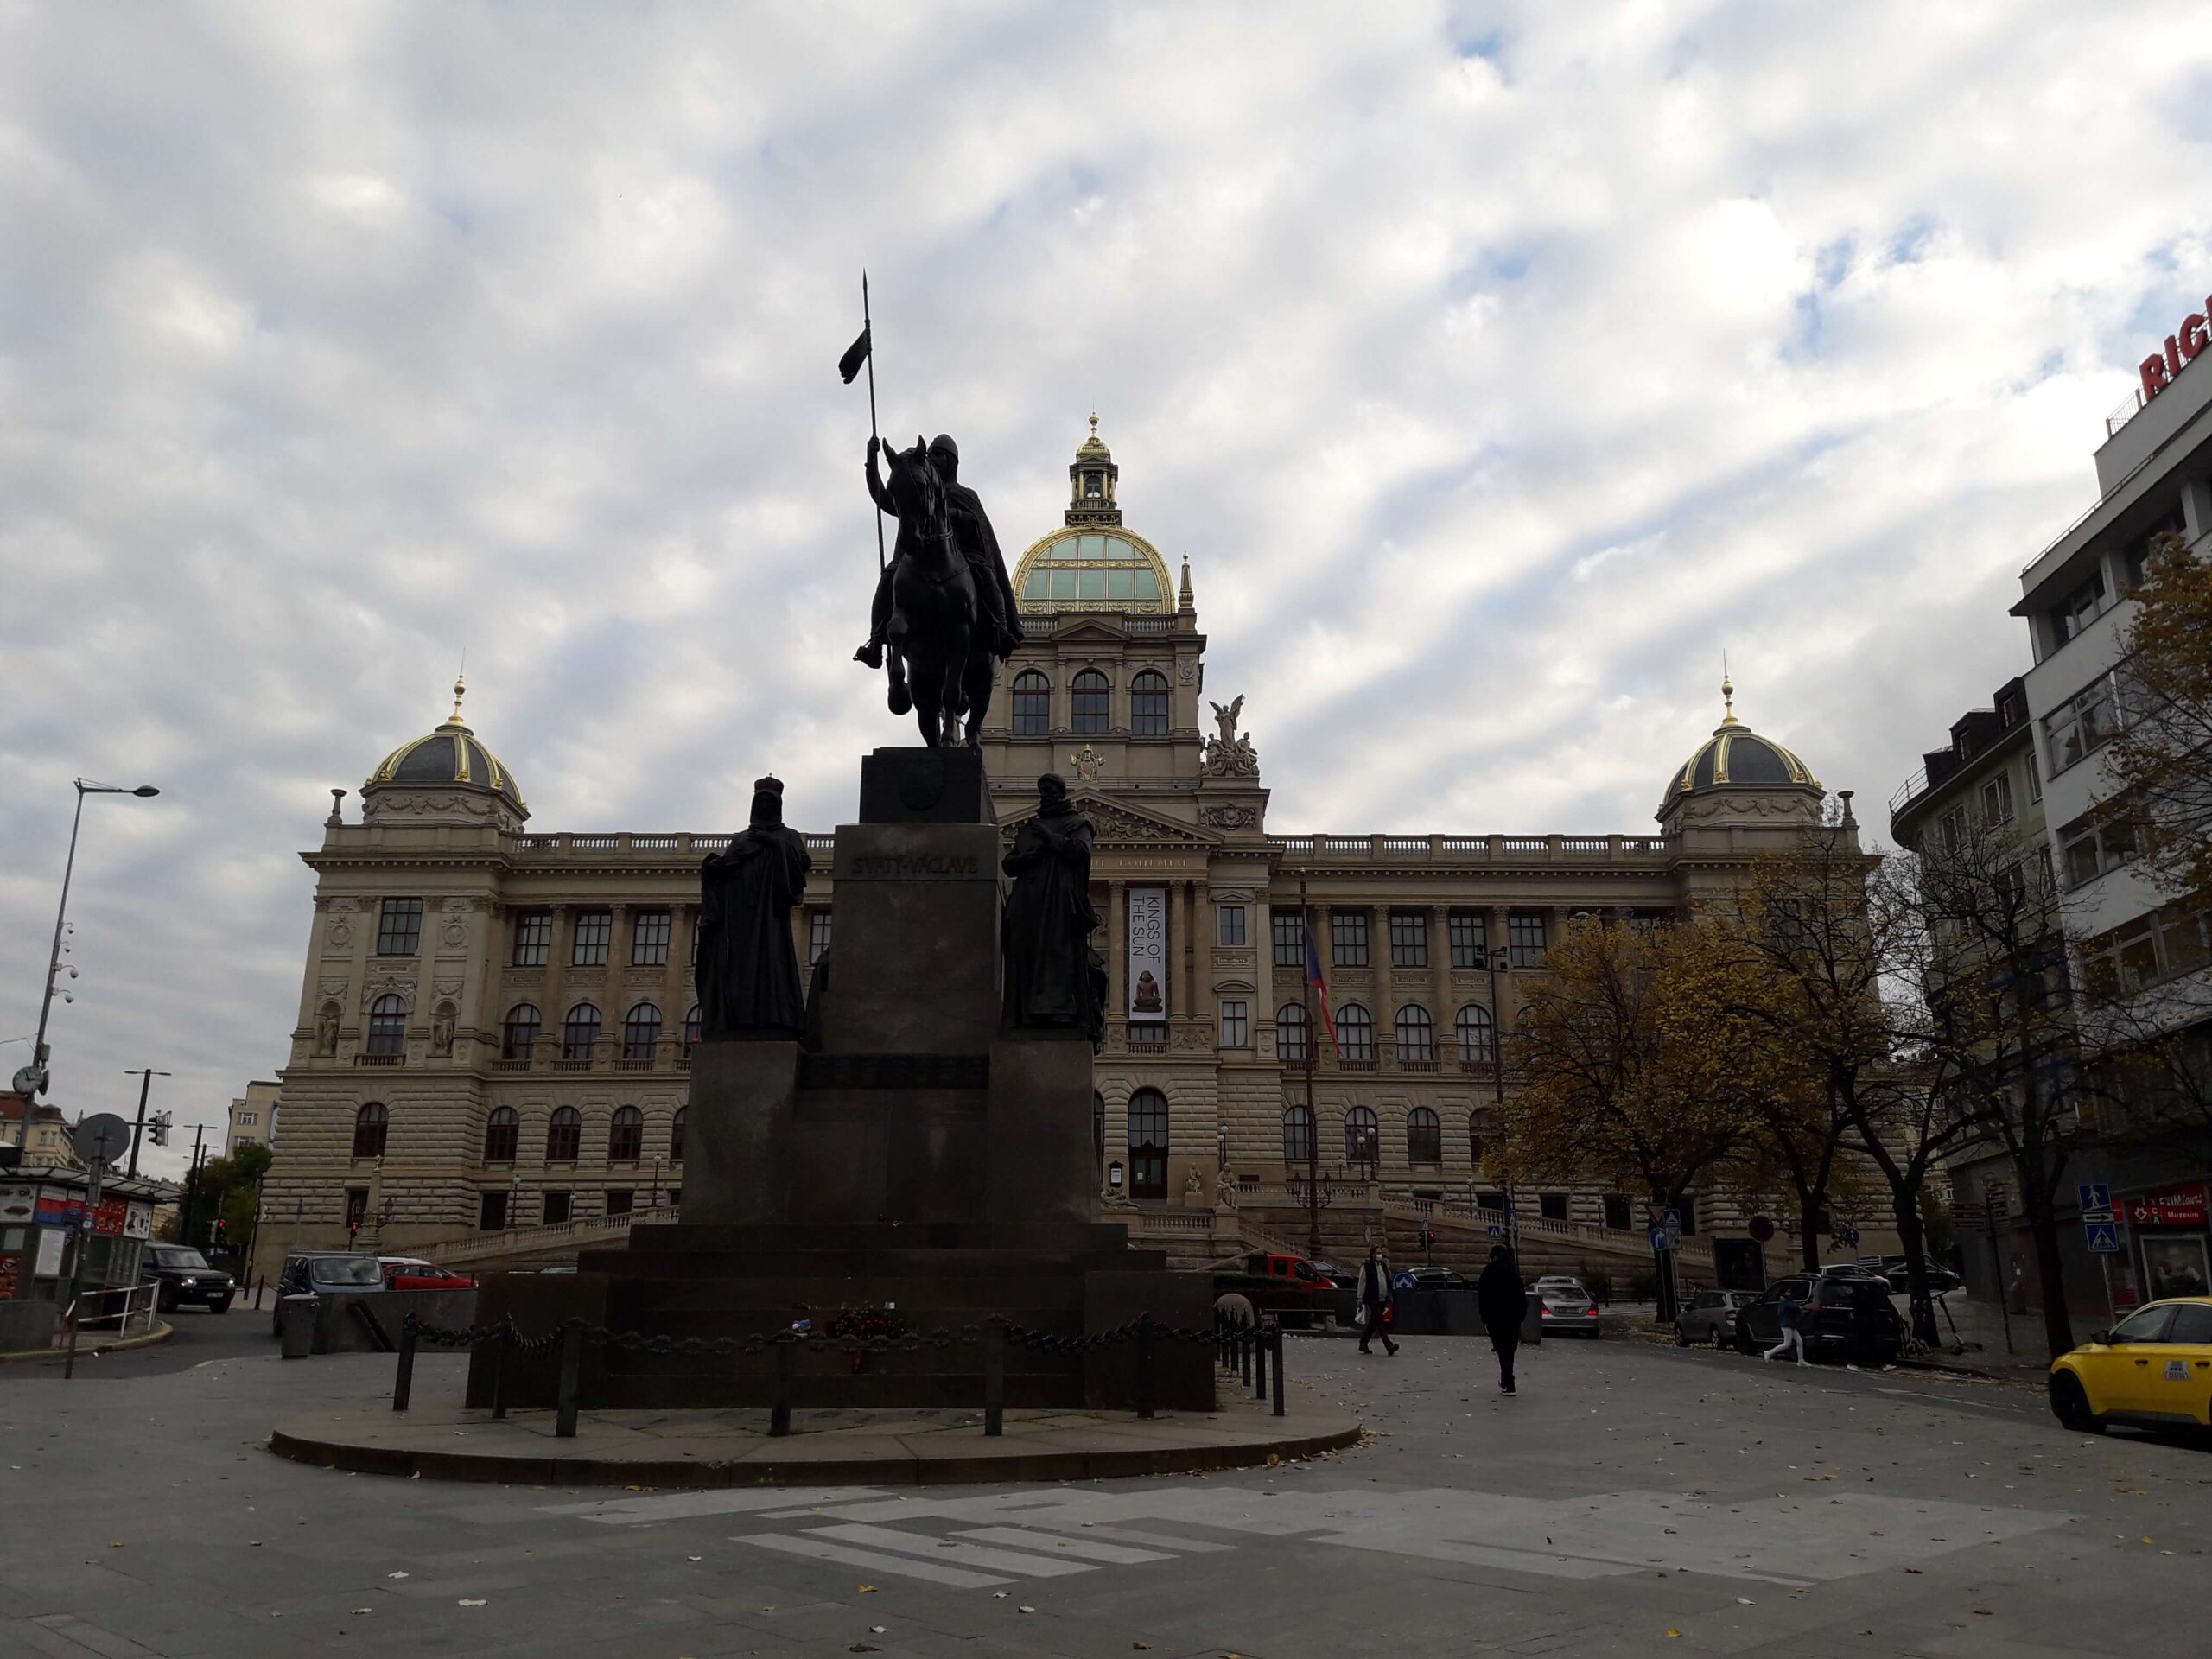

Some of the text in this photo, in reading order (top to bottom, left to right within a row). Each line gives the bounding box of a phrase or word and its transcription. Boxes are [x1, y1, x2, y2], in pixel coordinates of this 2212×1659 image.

[1132, 895, 1145, 956] THE SUN
[1147, 896, 1160, 963] KINGS OF
